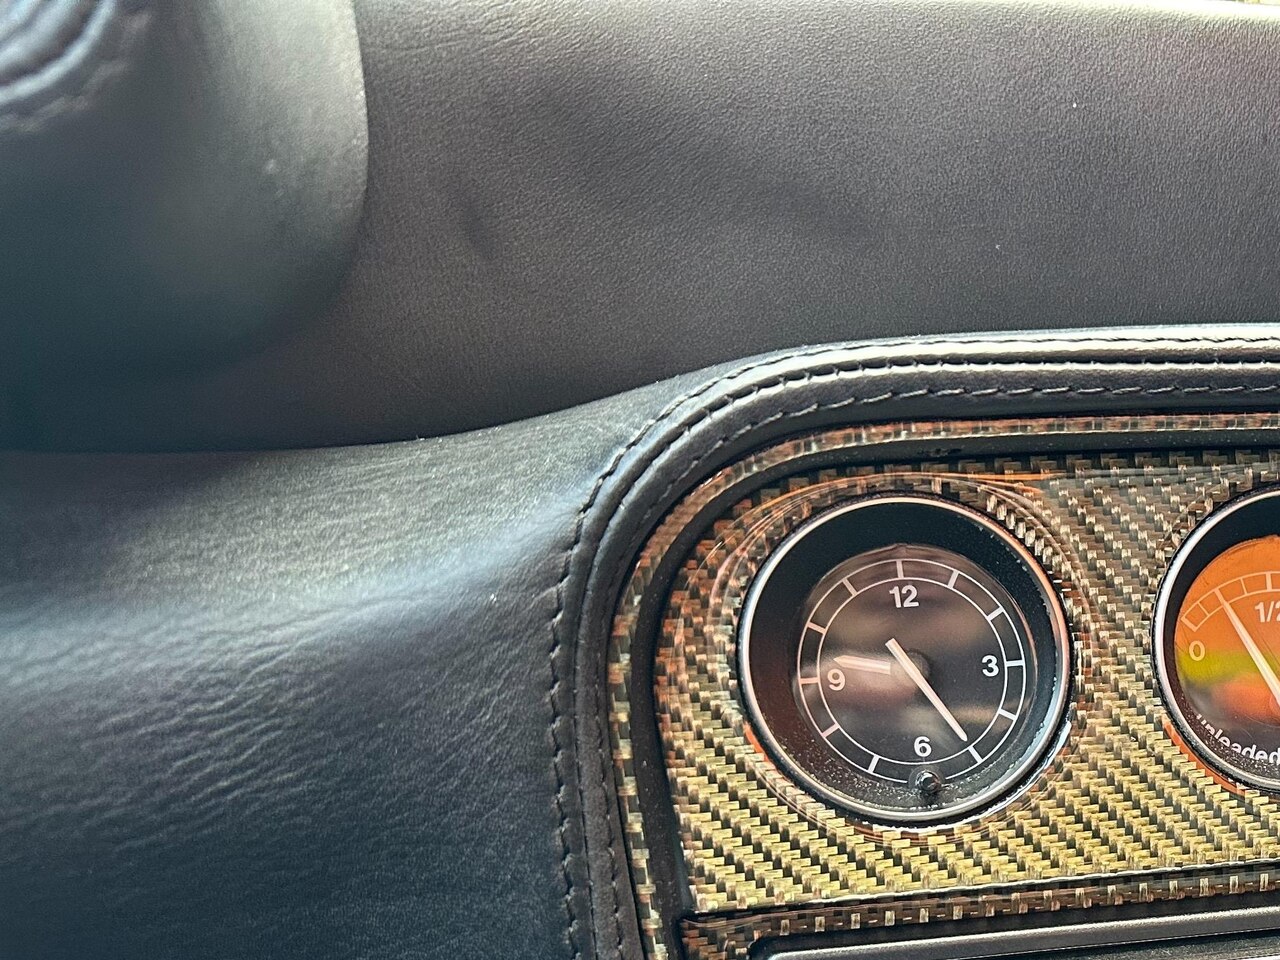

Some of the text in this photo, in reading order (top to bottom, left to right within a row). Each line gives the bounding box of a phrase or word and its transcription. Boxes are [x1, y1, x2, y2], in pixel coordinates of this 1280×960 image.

[889, 584, 919, 608] 12
[1188, 640, 1206, 662] 0
[982, 655, 999, 676] 3
[828, 669, 846, 690] 9
[914, 736, 932, 757] 6
